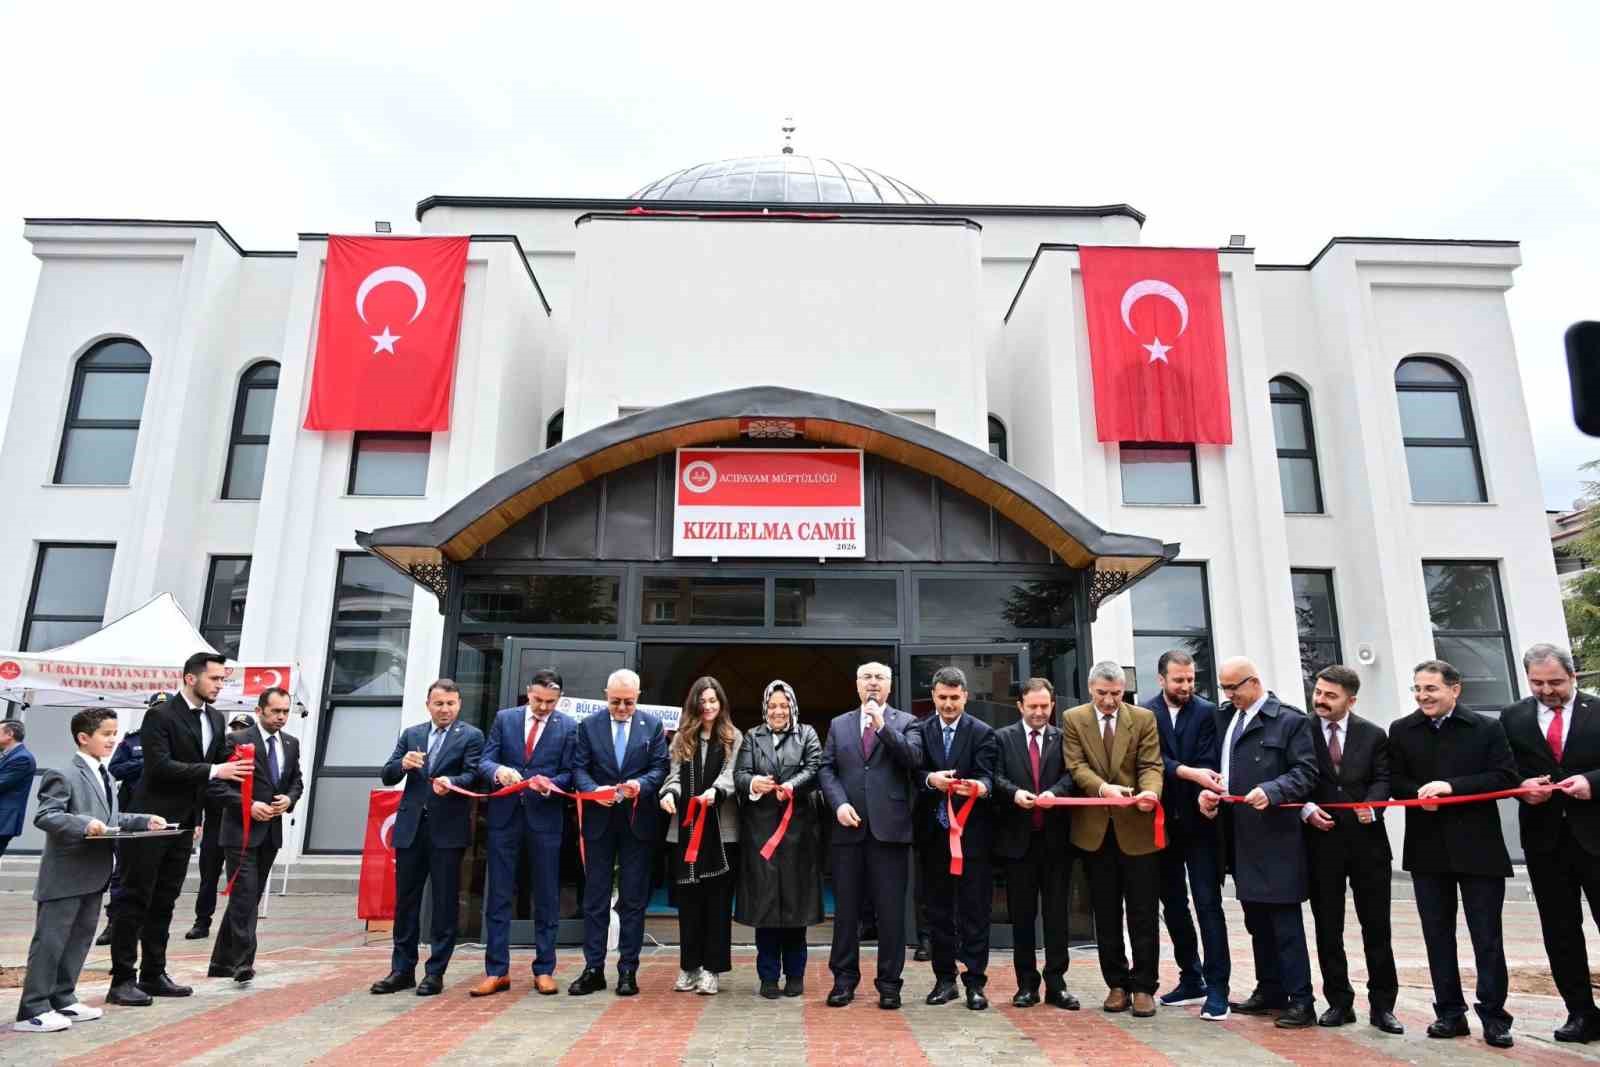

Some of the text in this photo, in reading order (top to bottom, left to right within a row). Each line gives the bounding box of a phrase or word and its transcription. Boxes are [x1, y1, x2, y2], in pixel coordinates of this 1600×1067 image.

[719, 473, 769, 484] ACIPAYAM
[683, 518, 856, 541] KIZILELMA CAMİİ
[836, 543, 857, 551] 2026
[39, 660, 98, 676] TÜRKİYE
[61, 678, 128, 691] ACIPAYAM
